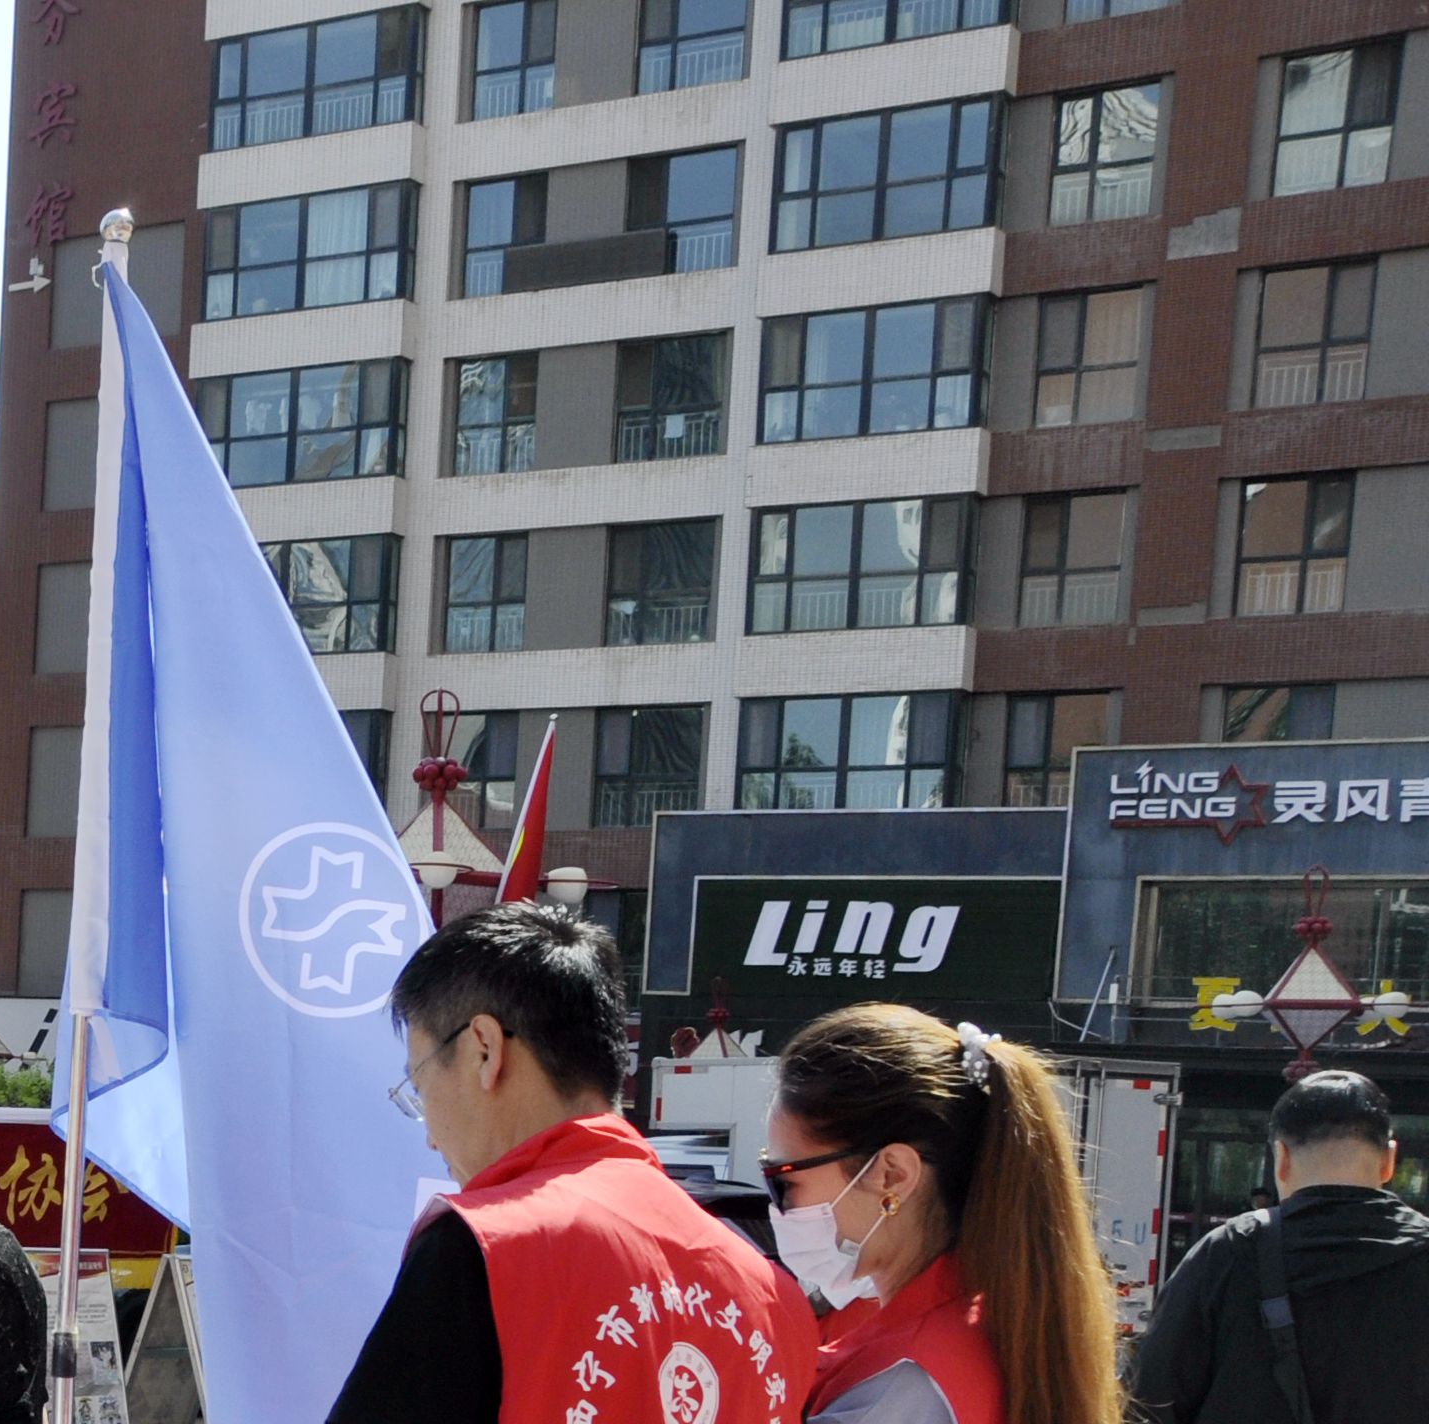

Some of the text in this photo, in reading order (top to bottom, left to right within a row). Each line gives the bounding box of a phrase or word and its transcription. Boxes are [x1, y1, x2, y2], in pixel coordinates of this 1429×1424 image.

[1108, 796, 1238, 821] FENG
[743, 899, 962, 973] Ling
[786, 956, 887, 979] 永远年轻
